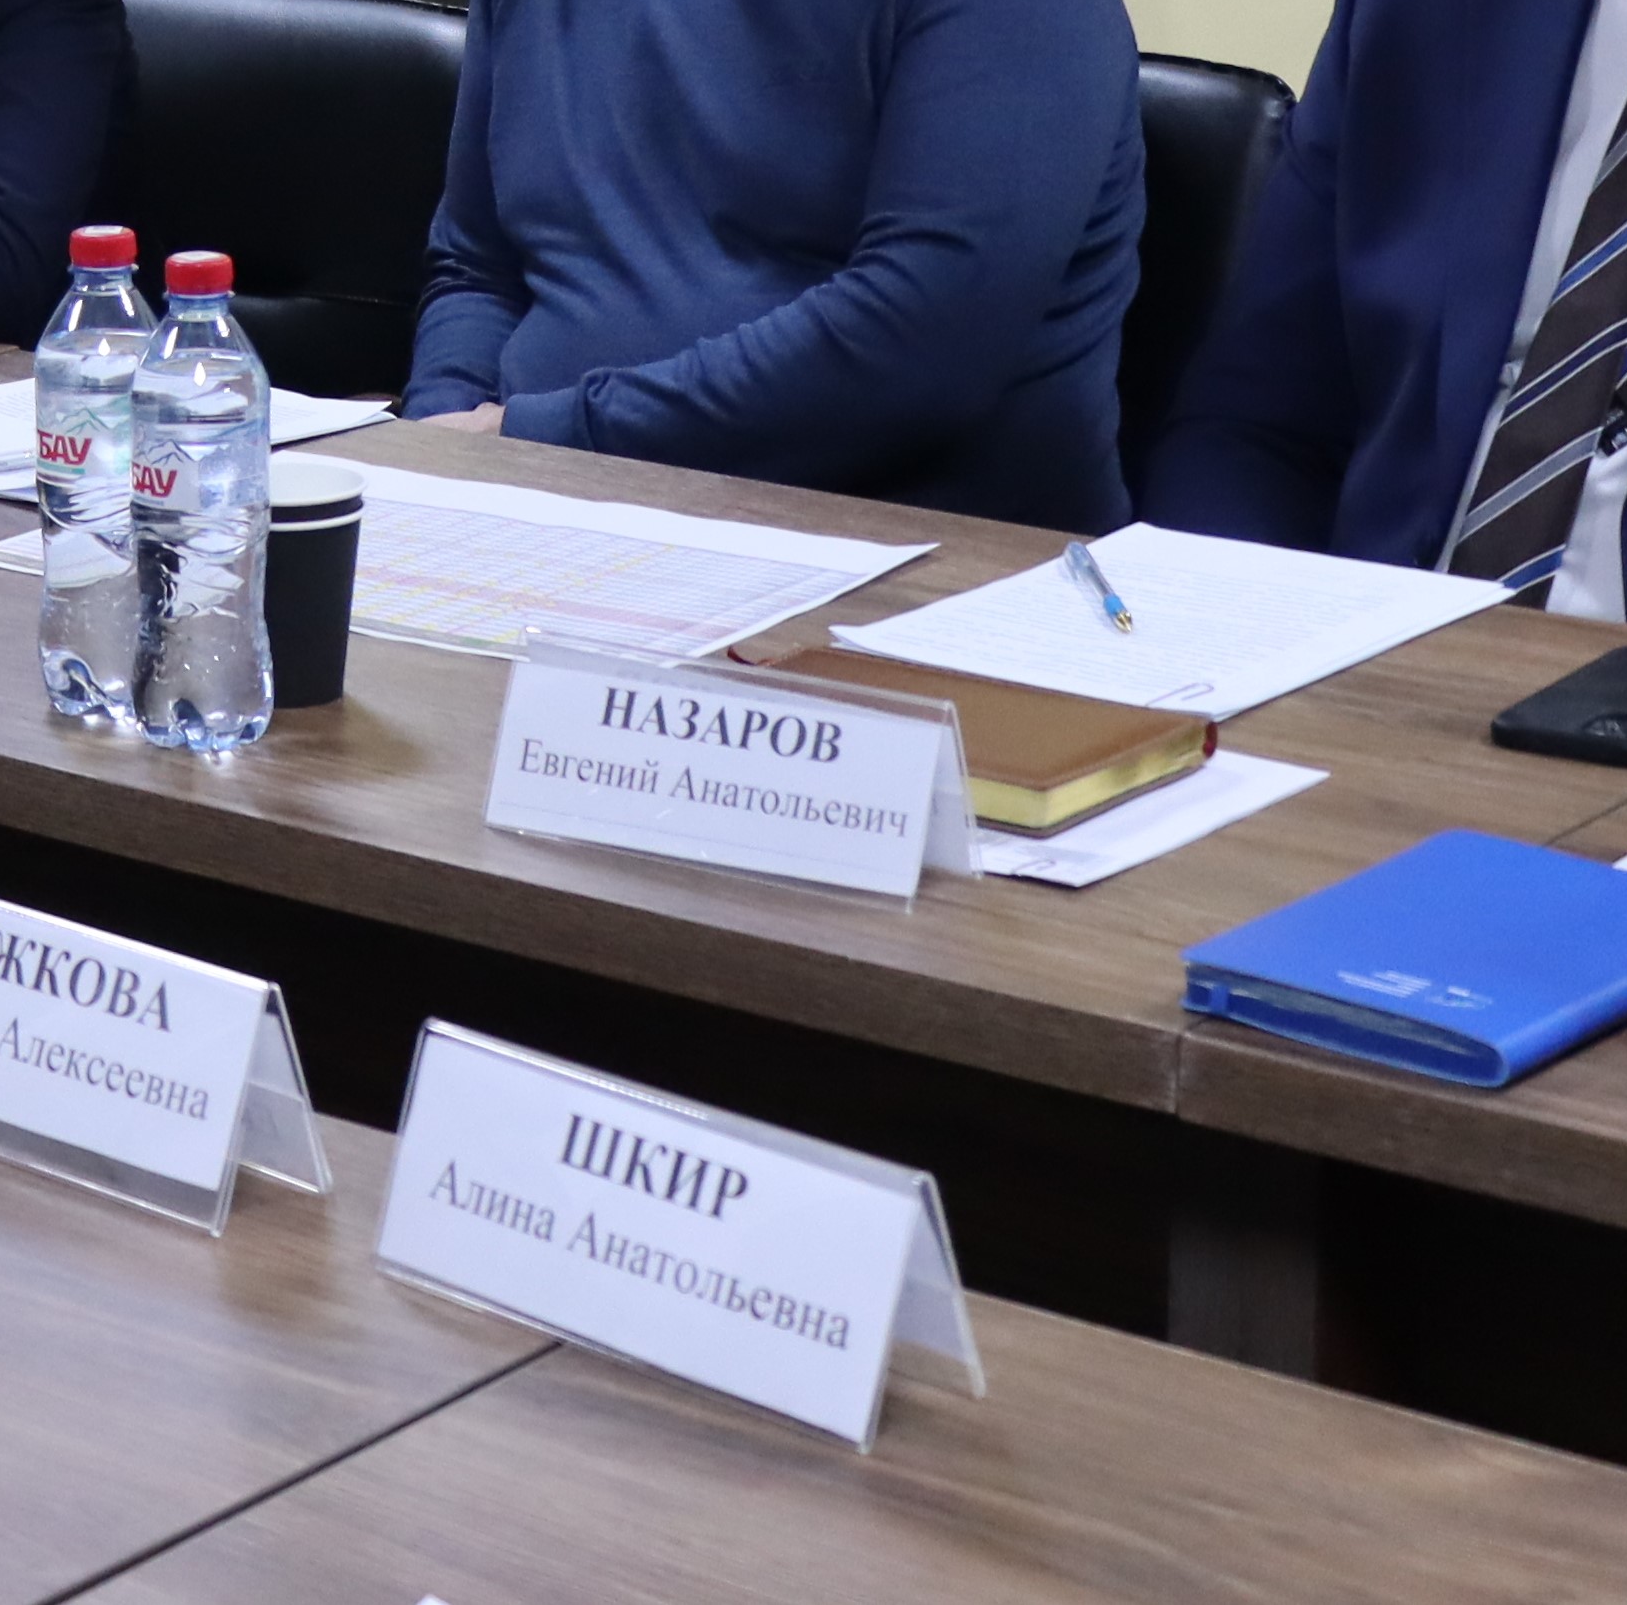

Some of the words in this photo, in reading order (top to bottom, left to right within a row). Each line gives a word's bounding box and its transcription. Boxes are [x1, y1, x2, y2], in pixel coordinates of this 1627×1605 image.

[37, 429, 92, 466] БАУ
[131, 461, 178, 498] БАУ
[598, 686, 843, 764] НАЗАРОВ
[517, 737, 660, 795] Евгений
[668, 765, 909, 839] Анатольевич
[559, 1112, 750, 1221] ШКИР
[428, 1159, 556, 1244] Алина
[566, 1210, 851, 1351] Анатольевна
